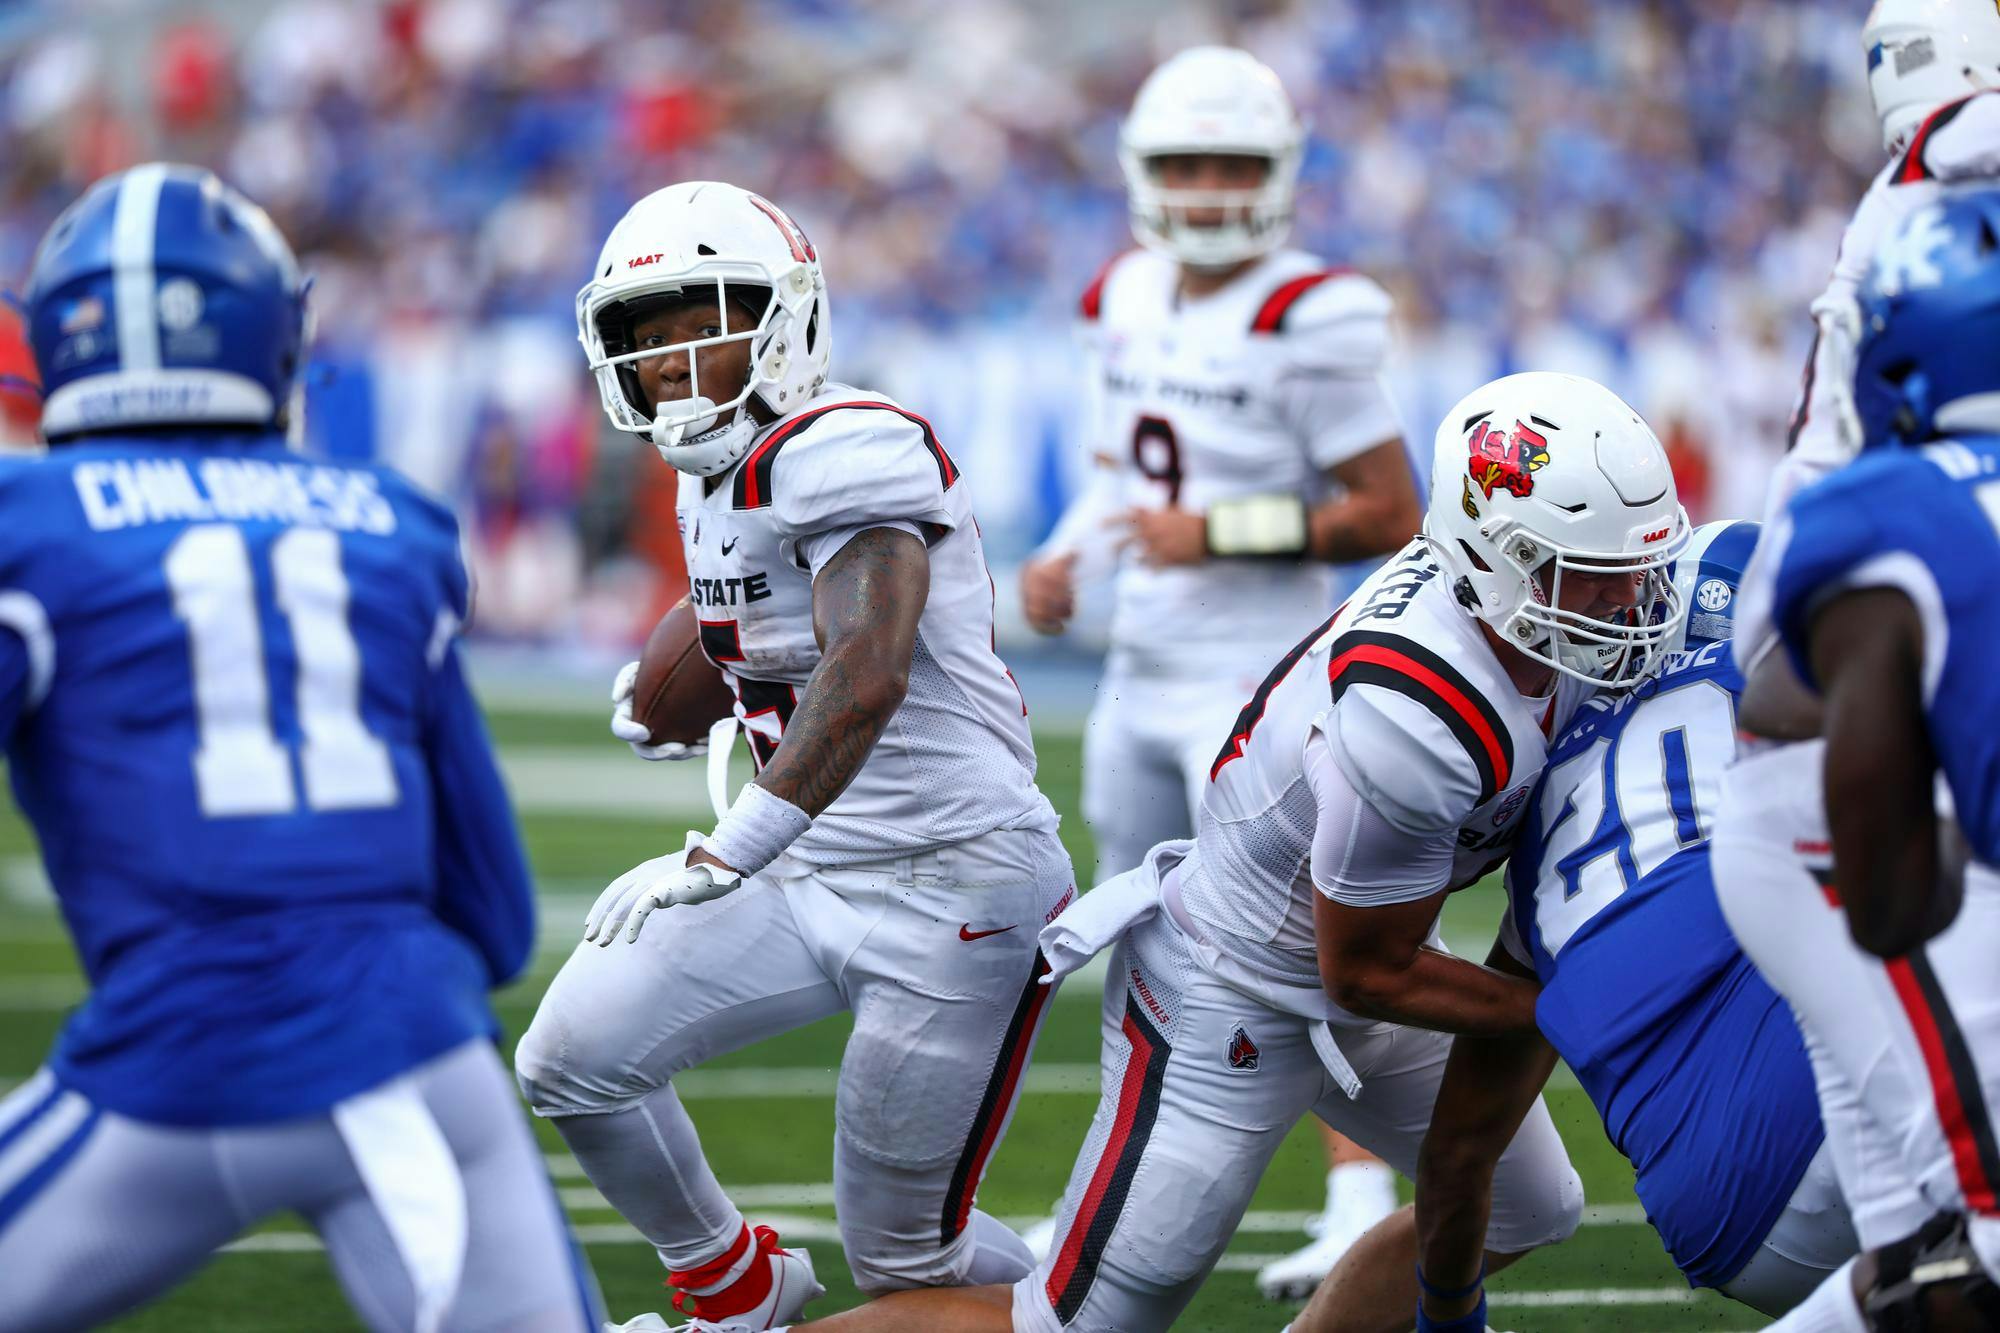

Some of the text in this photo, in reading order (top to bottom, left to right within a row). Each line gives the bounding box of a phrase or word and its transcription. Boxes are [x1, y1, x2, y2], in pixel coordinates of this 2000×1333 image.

[73, 457, 398, 536] CHILDRESS
[1133, 414, 1182, 507] 9
[694, 571, 772, 606] STATE
[1699, 580, 1730, 610] SEC
[165, 523, 399, 815] 11
[1534, 678, 1738, 960] 20
[1131, 969, 1169, 1025] CARDINALS
